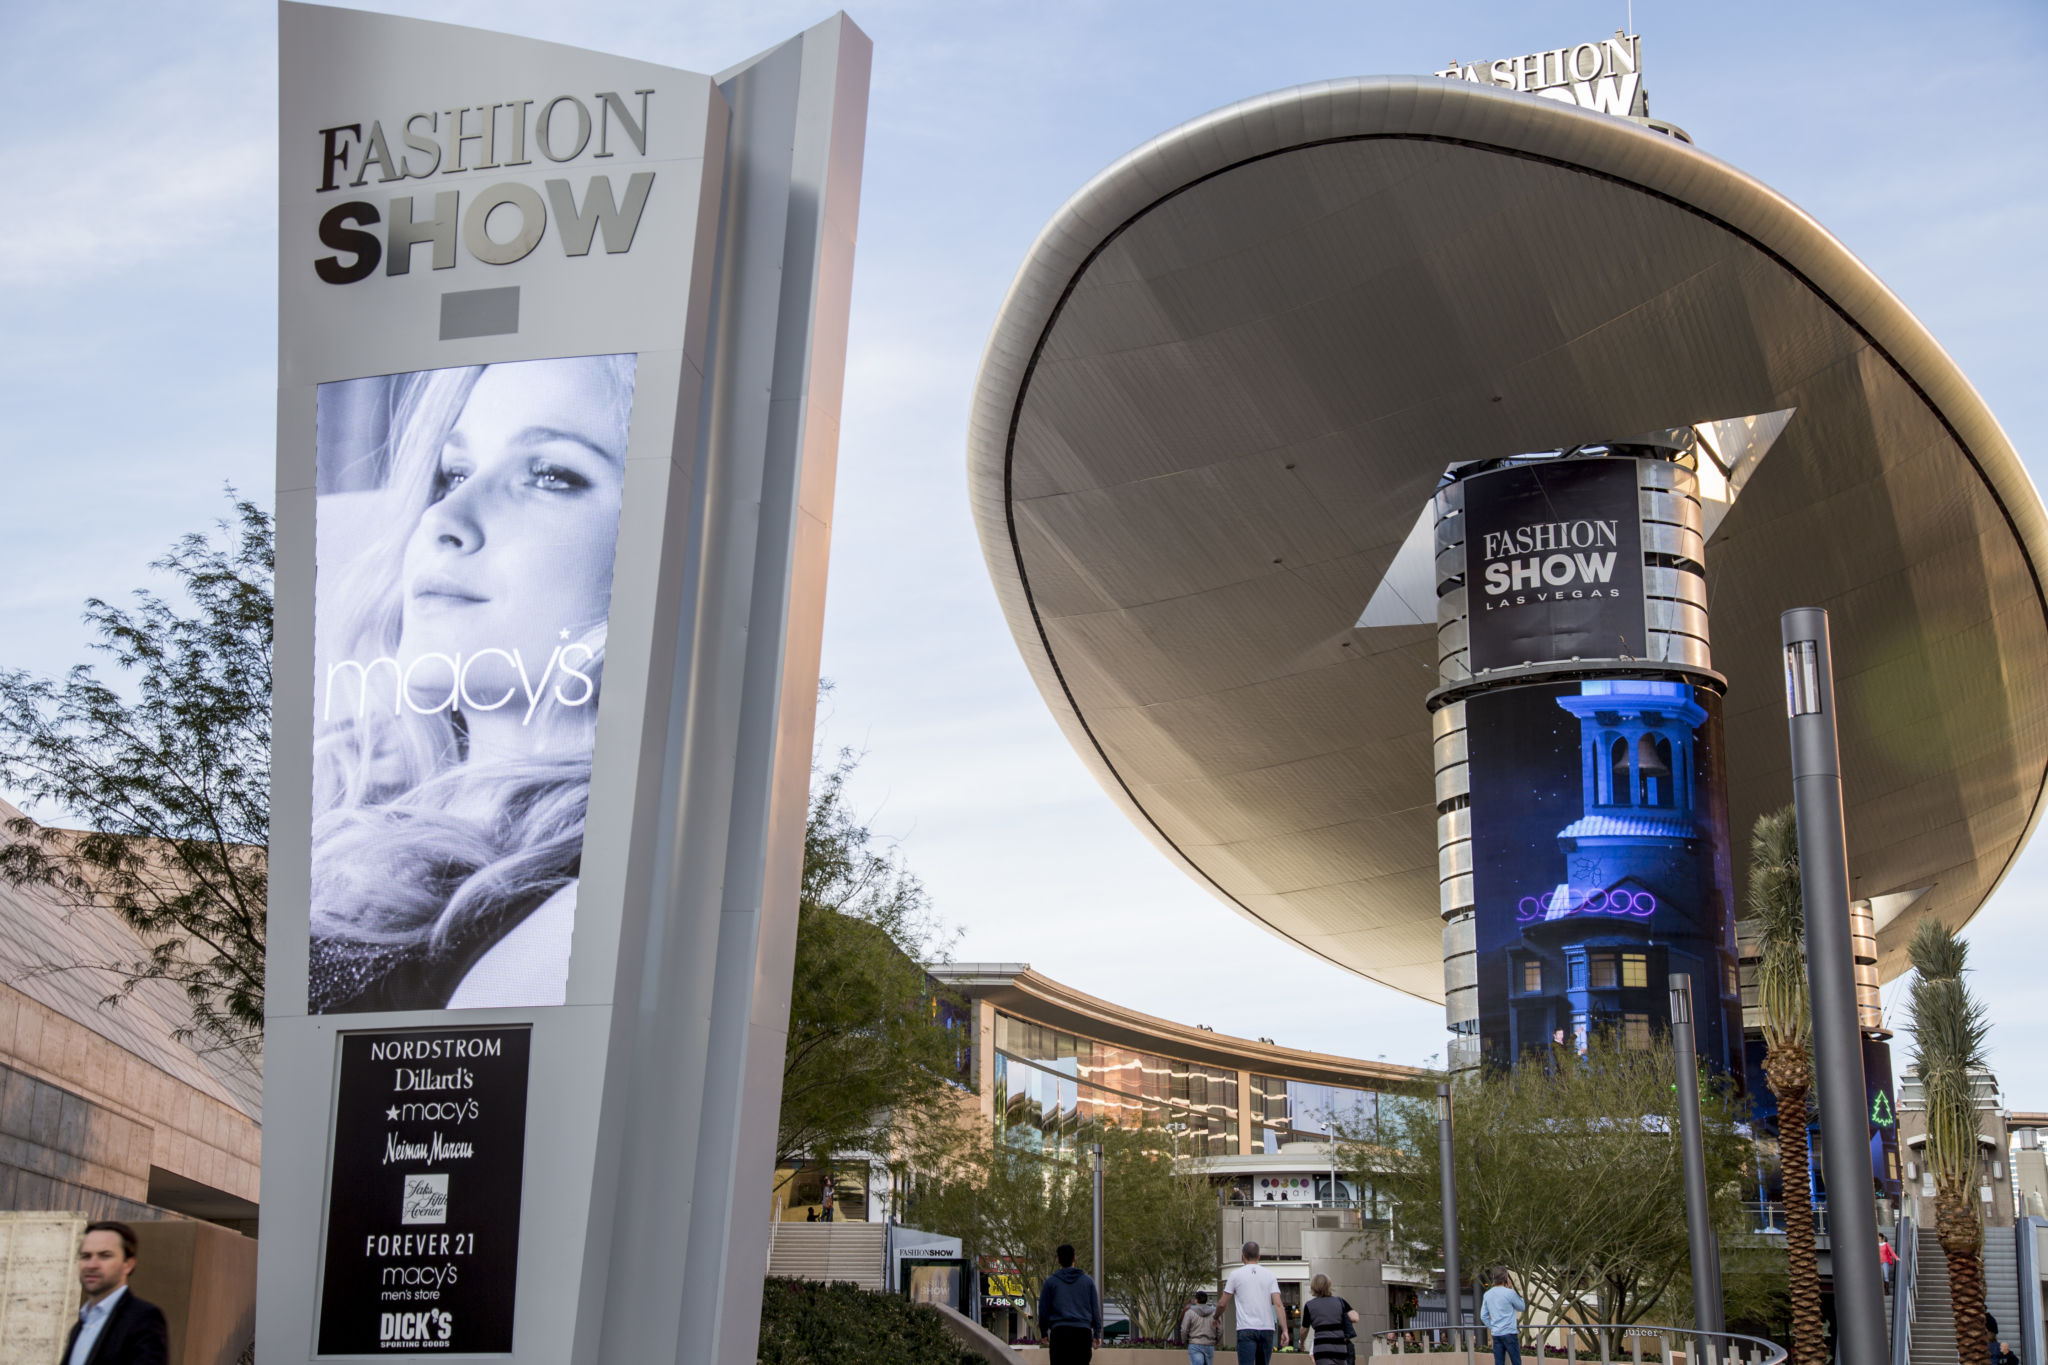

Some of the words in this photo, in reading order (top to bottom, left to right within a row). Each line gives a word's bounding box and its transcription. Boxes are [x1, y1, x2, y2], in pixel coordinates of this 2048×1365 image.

[1434, 34, 1639, 91] SHION
[316, 89, 655, 193] FASHION
[314, 172, 656, 285] SHOW
[1483, 520, 1618, 560] FASHION
[1484, 552, 1618, 595] SHOW
[1486, 596, 1526, 611] LAS
[1537, 588, 1620, 601] VEGAS
[324, 627, 593, 726] macy's
[371, 1038, 501, 1061] NORDSTROM
[394, 1067, 474, 1092] Dillard's
[402, 1098, 479, 1125] macy's
[383, 1131, 428, 1165] Neiman
[427, 1131, 475, 1166] Marcus
[406, 1180, 433, 1199] Saks
[403, 1201, 443, 1219] Avenue
[366, 1234, 450, 1256] FOREVER
[455, 1232, 474, 1255] 21
[382, 1262, 458, 1289] macy's
[381, 1289, 412, 1301] men's
[414, 1288, 440, 1300] store
[380, 1307, 452, 1341] DICK'S
[380, 1340, 420, 1348] SPORTING
[422, 1340, 450, 1348] GOODS
